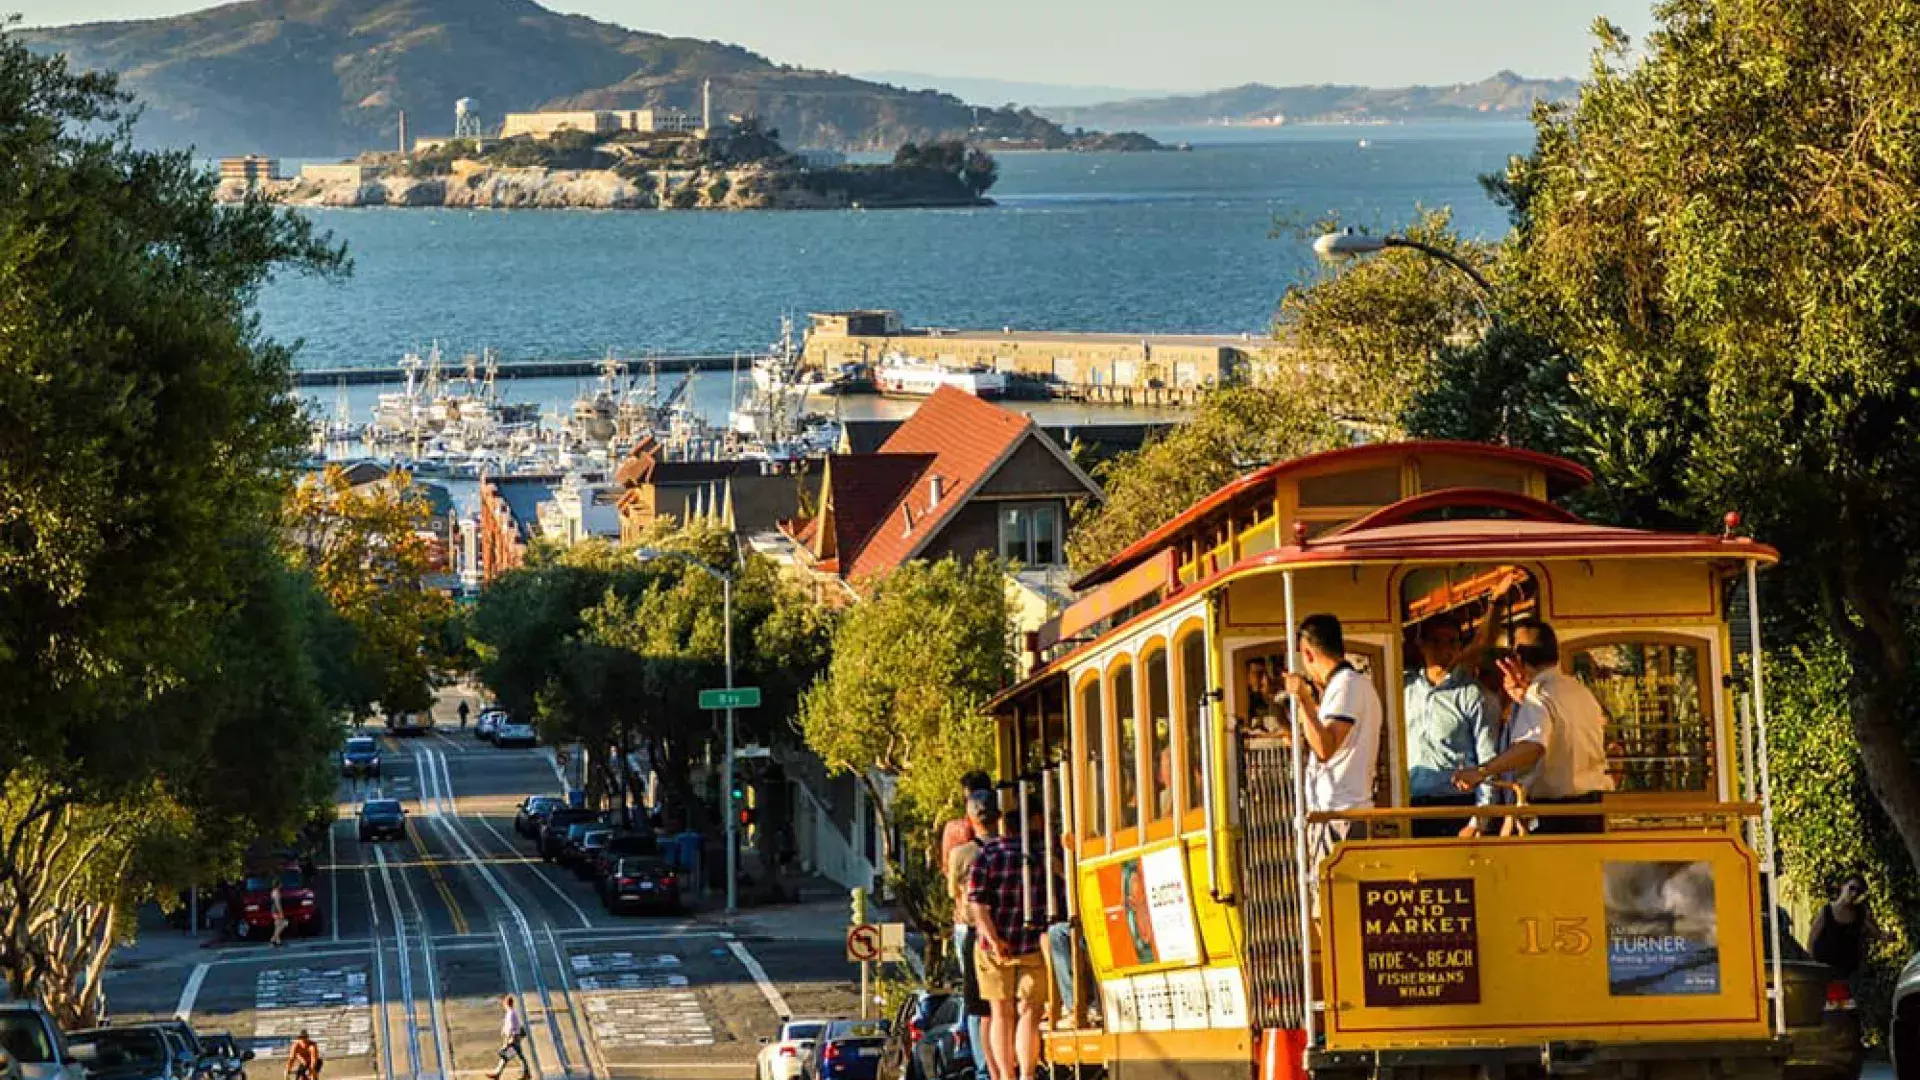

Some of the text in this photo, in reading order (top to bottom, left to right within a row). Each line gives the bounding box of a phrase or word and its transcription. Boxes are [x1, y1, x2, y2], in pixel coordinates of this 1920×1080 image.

[719, 693, 740, 705] Bay
[1366, 888, 1470, 906] POWELL
[1394, 904, 1444, 917] AND
[1366, 917, 1472, 935] MARKET
[1517, 916, 1592, 955] 15
[1612, 935, 1686, 953] TURNER
[1368, 951, 1404, 970] HYDE
[1427, 949, 1473, 968] BEACH
[1378, 971, 1464, 986] FISHERMANS
[1399, 984, 1442, 998] WHARF
